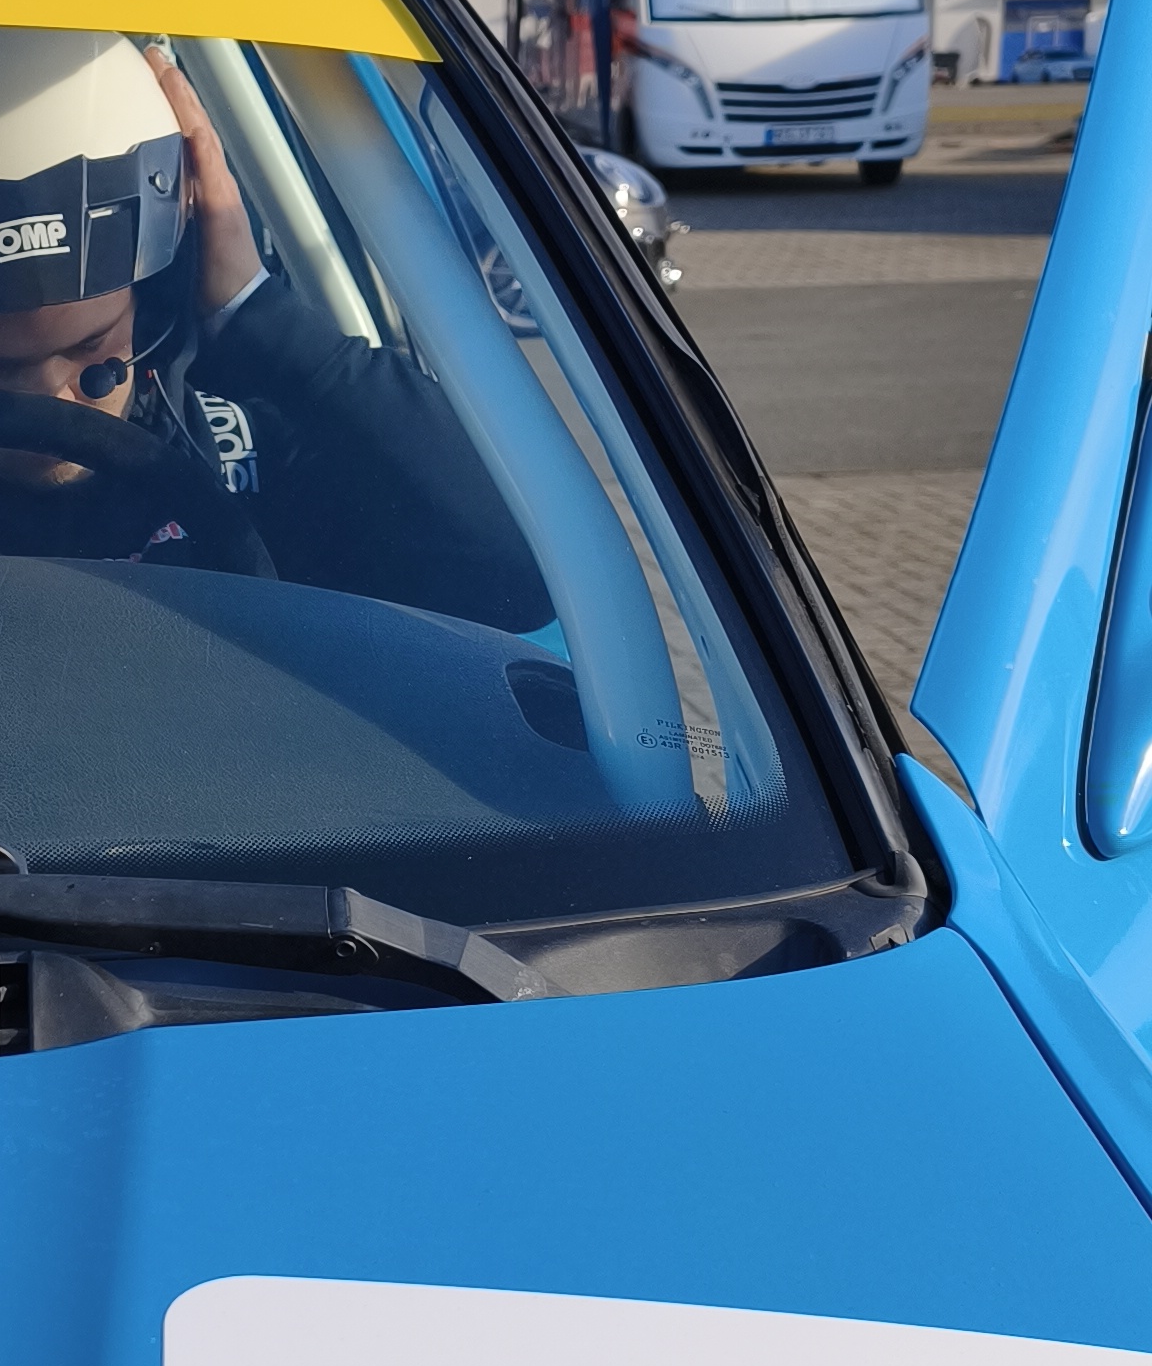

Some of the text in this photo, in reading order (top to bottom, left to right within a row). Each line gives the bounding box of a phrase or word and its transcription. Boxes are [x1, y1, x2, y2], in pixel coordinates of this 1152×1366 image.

[656, 718, 721, 736] PILKINGTON
[668, 730, 713, 744] LAMINATED
[660, 740, 682, 750] 43R
